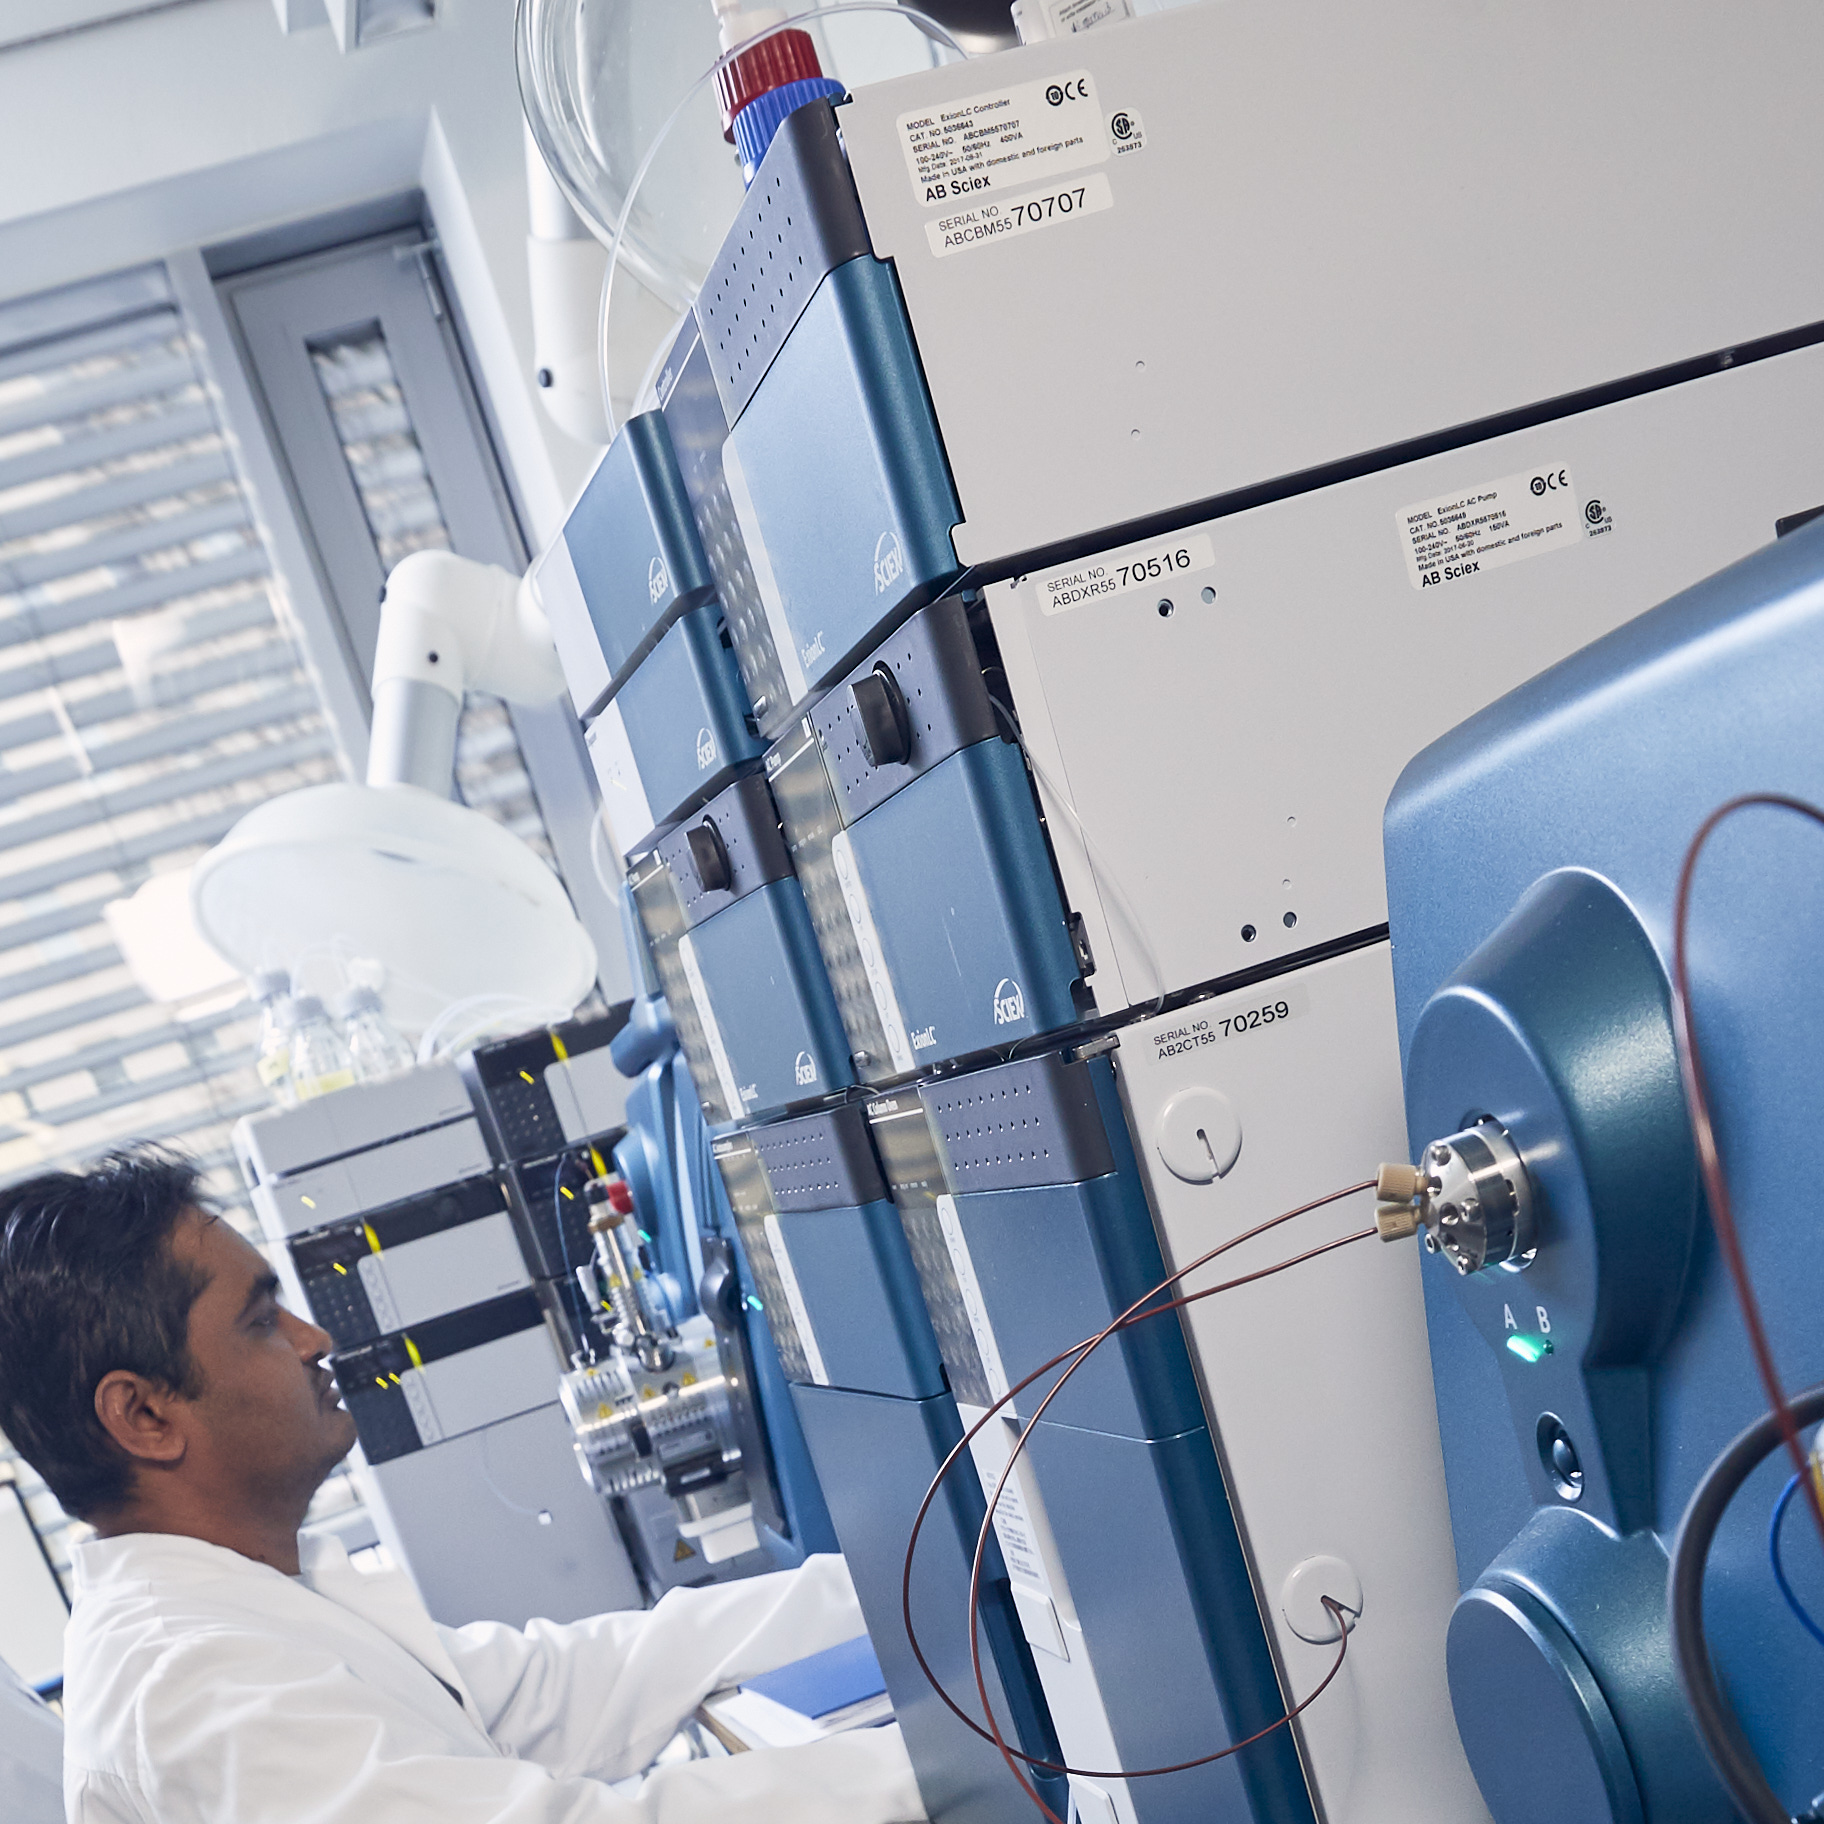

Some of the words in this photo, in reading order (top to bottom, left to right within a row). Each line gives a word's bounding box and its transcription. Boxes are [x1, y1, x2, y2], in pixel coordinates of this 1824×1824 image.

[906, 117, 935, 131] MODEL
[940, 107, 973, 123] ExionLC
[973, 98, 1011, 115] Controller
[912, 140, 941, 154] SERIAL
[920, 171, 941, 184] Made
[952, 164, 968, 176] USA
[969, 160, 985, 172] with
[986, 152, 1021, 168] domestic
[1022, 149, 1036, 160] and
[1036, 140, 1064, 157] foreign
[1064, 135, 1085, 151] parts
[926, 184, 948, 202] AB
[950, 175, 992, 196] Sciex
[938, 212, 980, 232] SERIAL
[944, 217, 1014, 248] ABCBM55
[1010, 188, 1088, 227] 70707
[1407, 511, 1433, 525] MODEL
[1437, 500, 1466, 516] ExionLC
[1466, 496, 1476, 507] AC
[1477, 491, 1498, 504] Pump
[1411, 533, 1437, 546] SERIAL
[1418, 560, 1437, 572] Made
[1445, 553, 1460, 564] USA
[1460, 549, 1476, 560] with
[1476, 539, 1507, 554] domestic
[1507, 536, 1521, 546] and
[1521, 527, 1546, 543] foreign
[1545, 521, 1564, 535] parts
[1046, 574, 1087, 594] SERIAL
[1087, 566, 1109, 581] NO.
[1051, 577, 1117, 609] ABDXR55
[1115, 548, 1191, 588] 70516
[1422, 571, 1442, 588] AB
[1444, 560, 1481, 581] Sciex
[993, 994, 1025, 1025] SCIEX
[1153, 1027, 1191, 1046] SERIAL
[1157, 1031, 1217, 1060] AB2CT55
[1218, 1001, 1290, 1037] 70259
[1504, 1303, 1518, 1330] A
[1536, 1305, 1551, 1334] B
